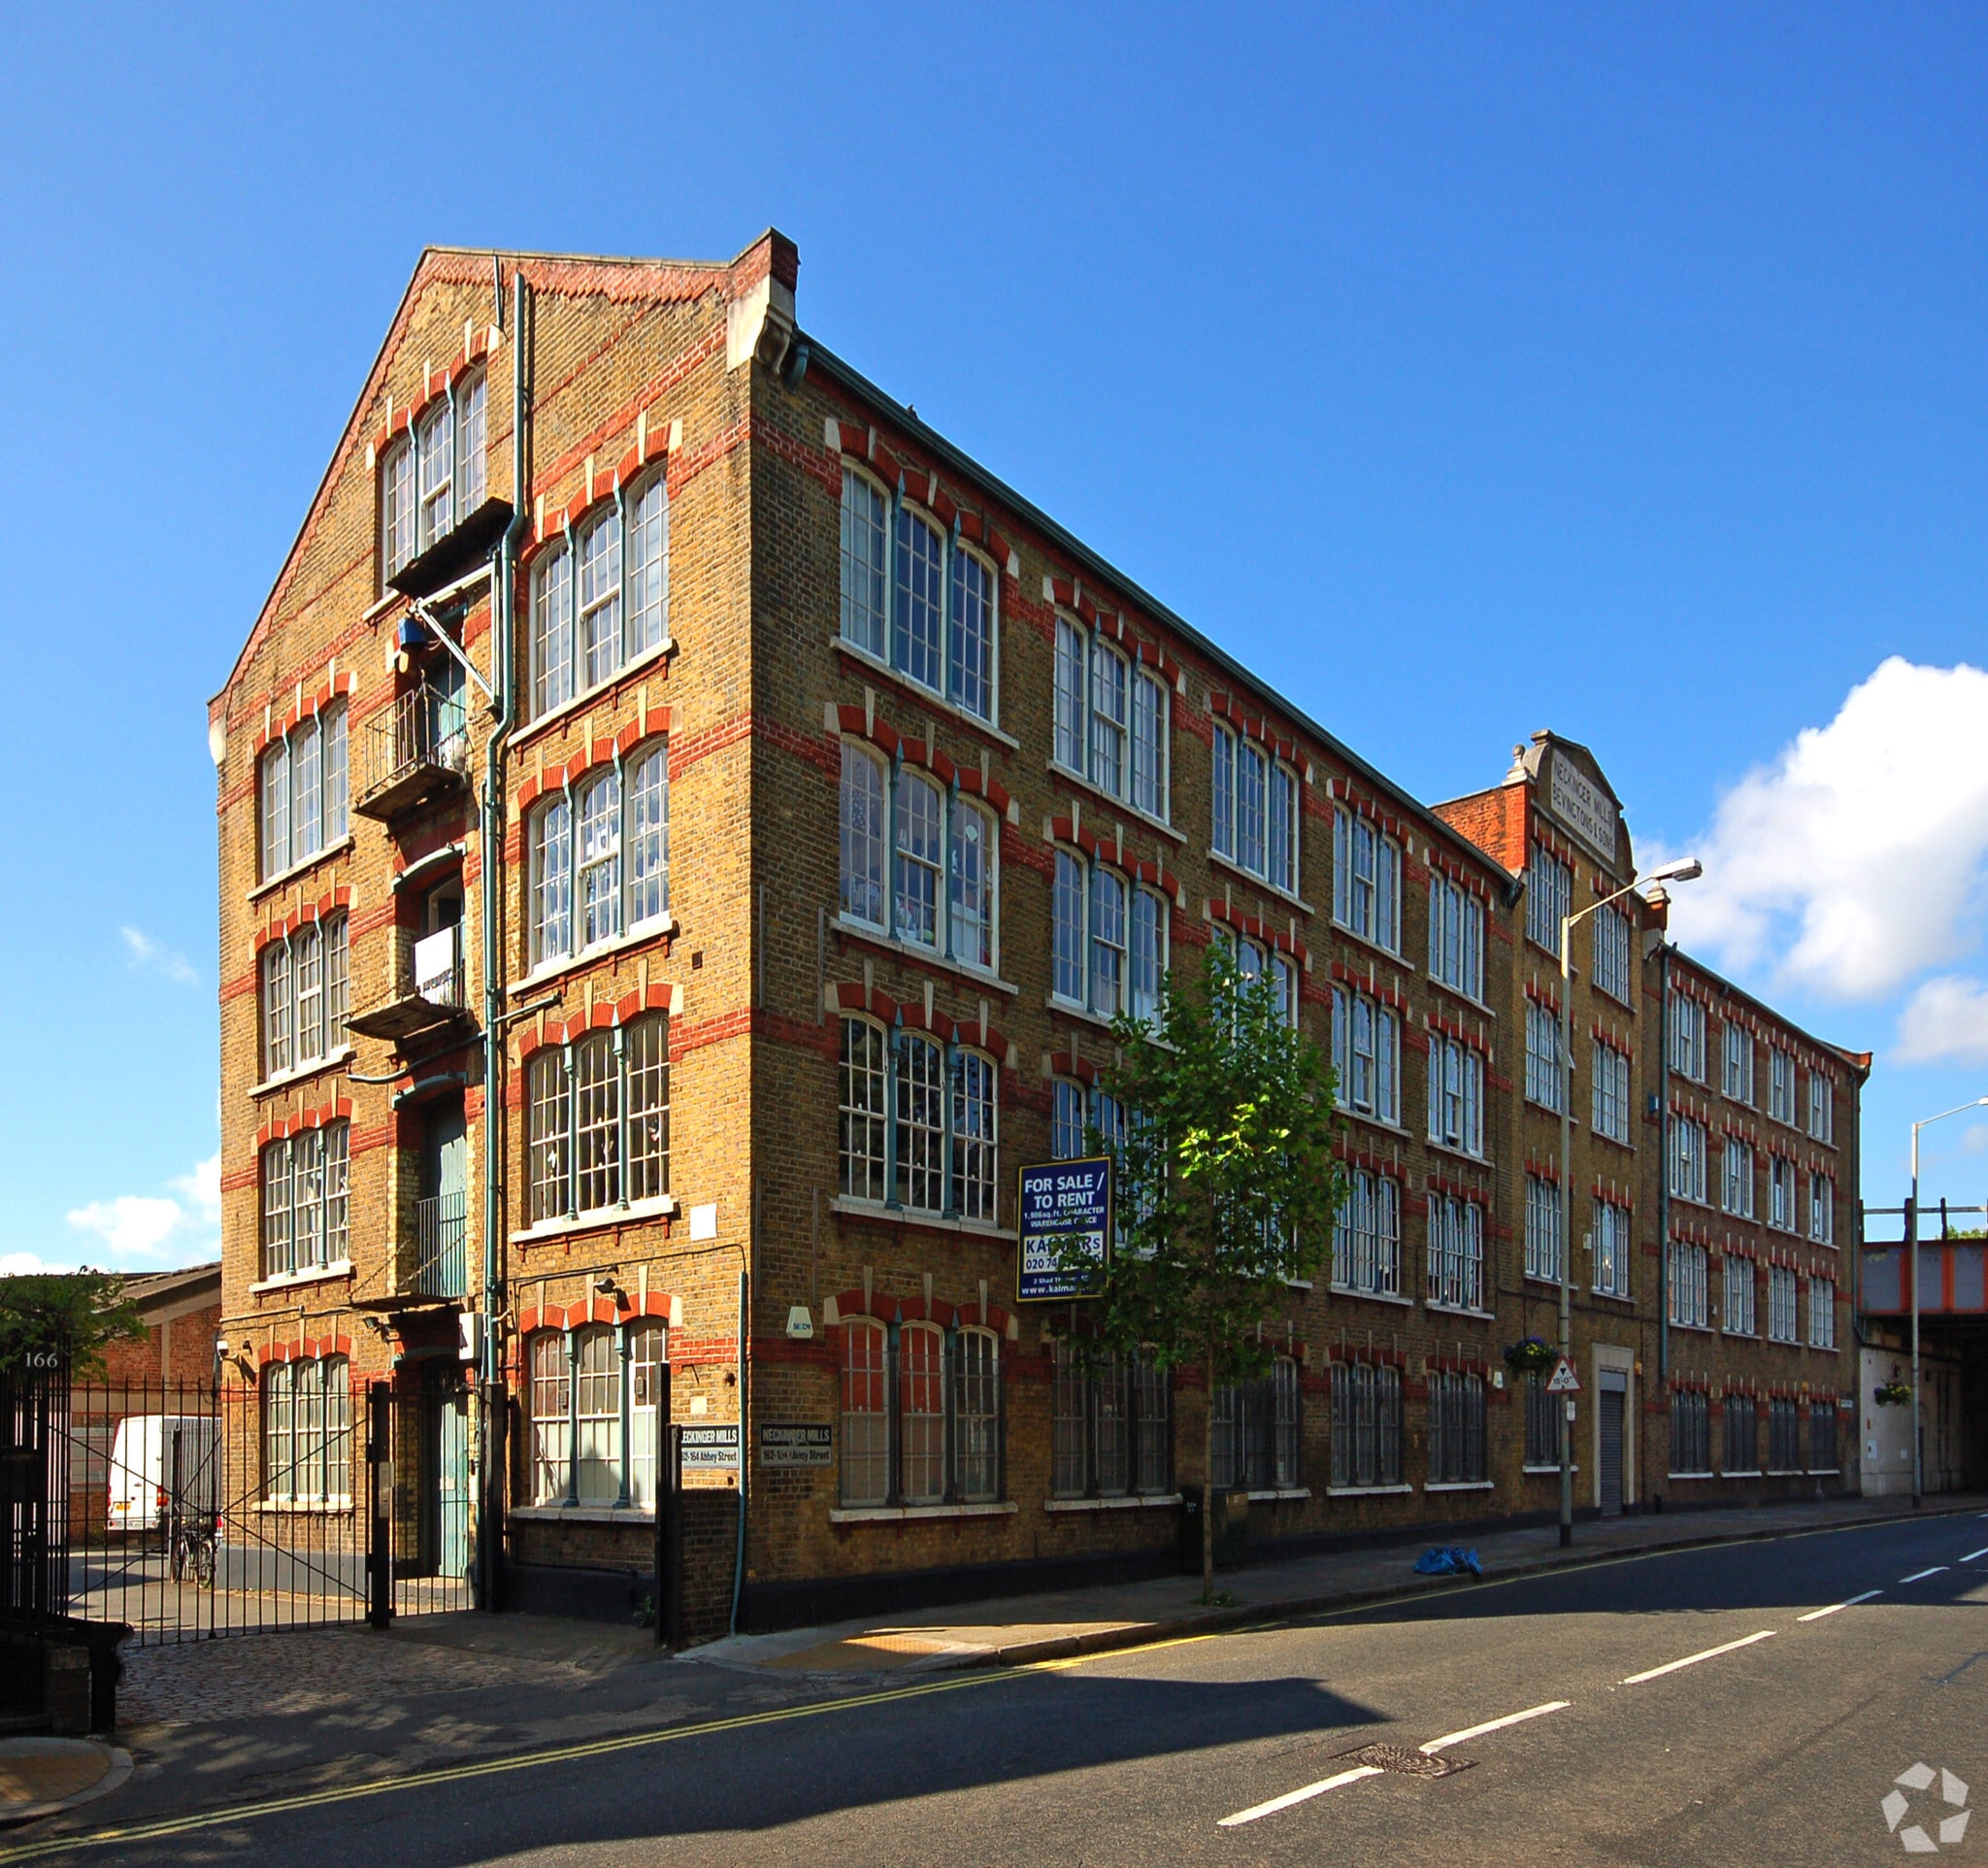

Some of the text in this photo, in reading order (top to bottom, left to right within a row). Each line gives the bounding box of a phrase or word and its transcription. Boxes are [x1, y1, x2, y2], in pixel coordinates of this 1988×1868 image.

[1024, 1178, 1052, 1193] FOR
[1056, 1174, 1093, 1190] SALE
[1034, 1191, 1095, 1210] TO RENT
[1063, 1206, 1105, 1217] CARACTER
[1026, 1258, 1044, 1270] 020
[26, 1351, 58, 1368] 166
[681, 1429, 738, 1444] ECKINGER MILLS
[807, 1429, 830, 1443] MILLS
[700, 1451, 717, 1464] Abbey
[717, 1451, 737, 1461] Street
[809, 1450, 830, 1460] Street
